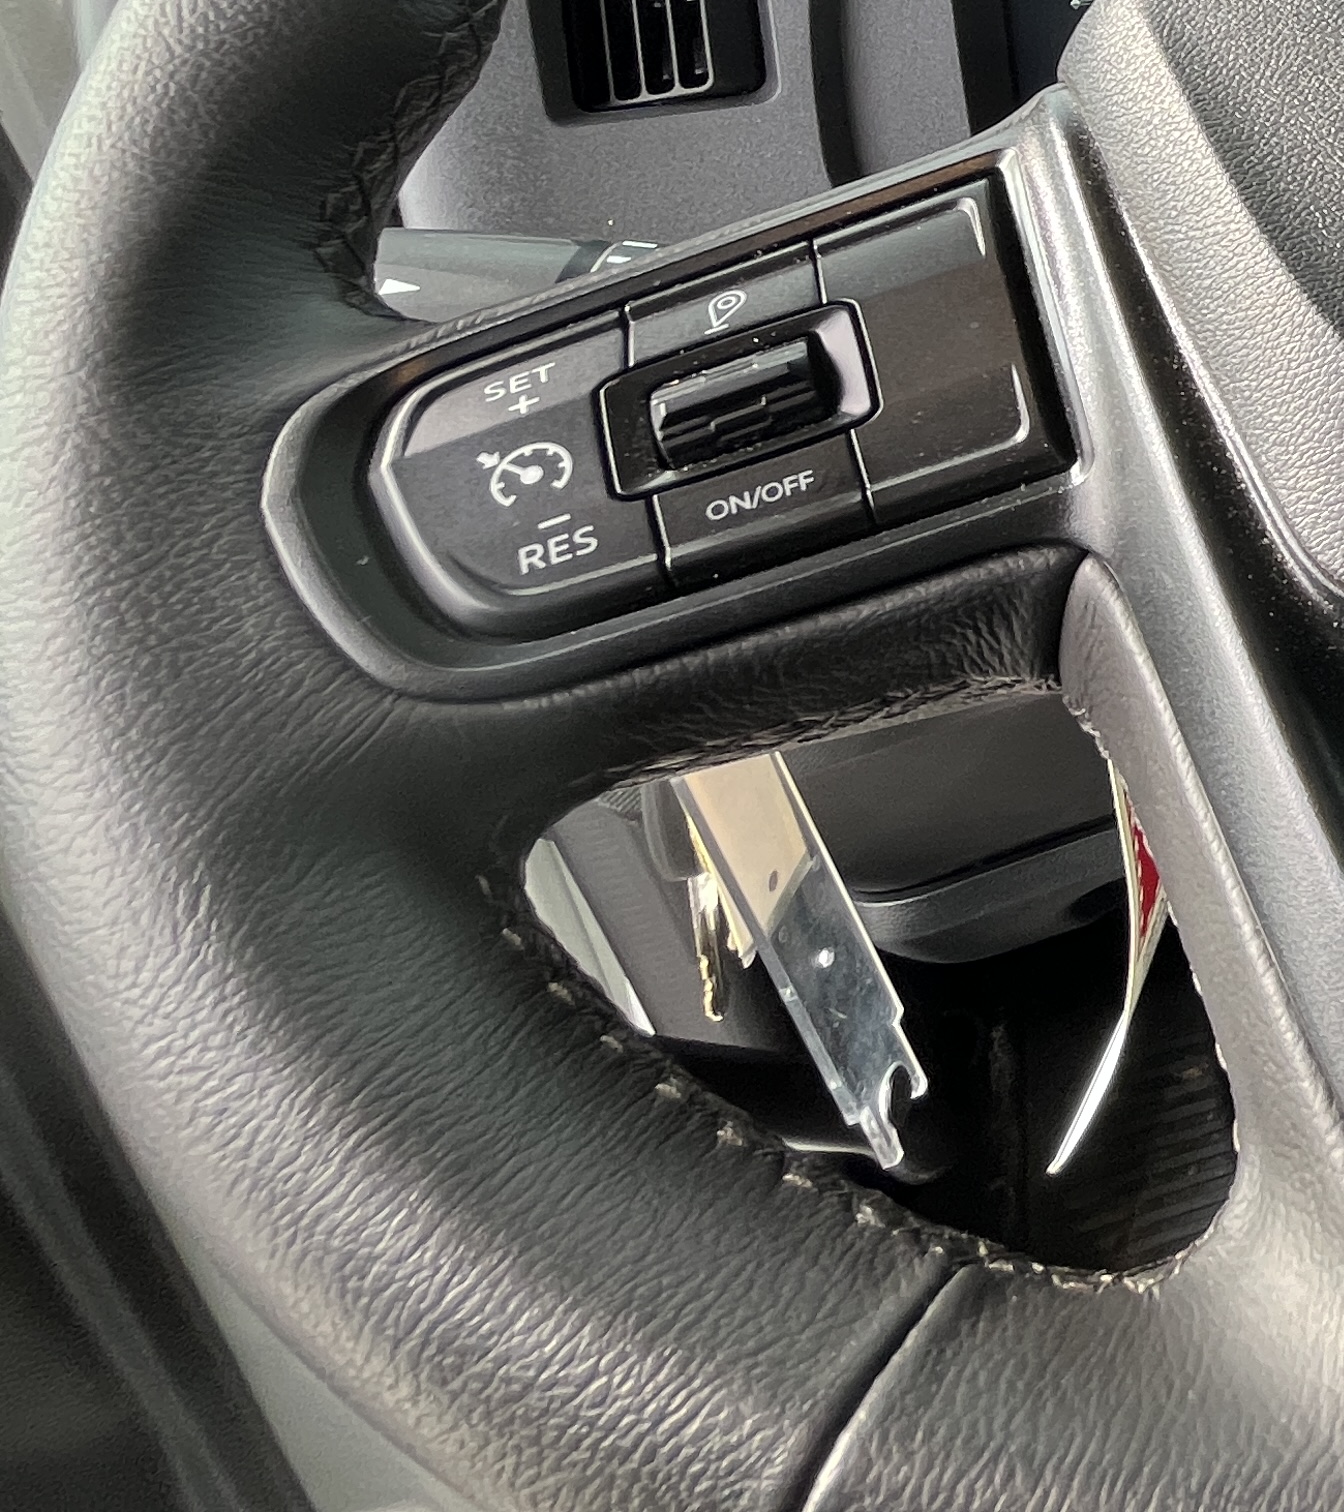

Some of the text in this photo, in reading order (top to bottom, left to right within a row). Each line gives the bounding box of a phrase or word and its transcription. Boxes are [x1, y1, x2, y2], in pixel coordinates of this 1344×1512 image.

[483, 362, 556, 401] SET
[703, 468, 816, 522] ON/OFF
[517, 524, 600, 575] RES
